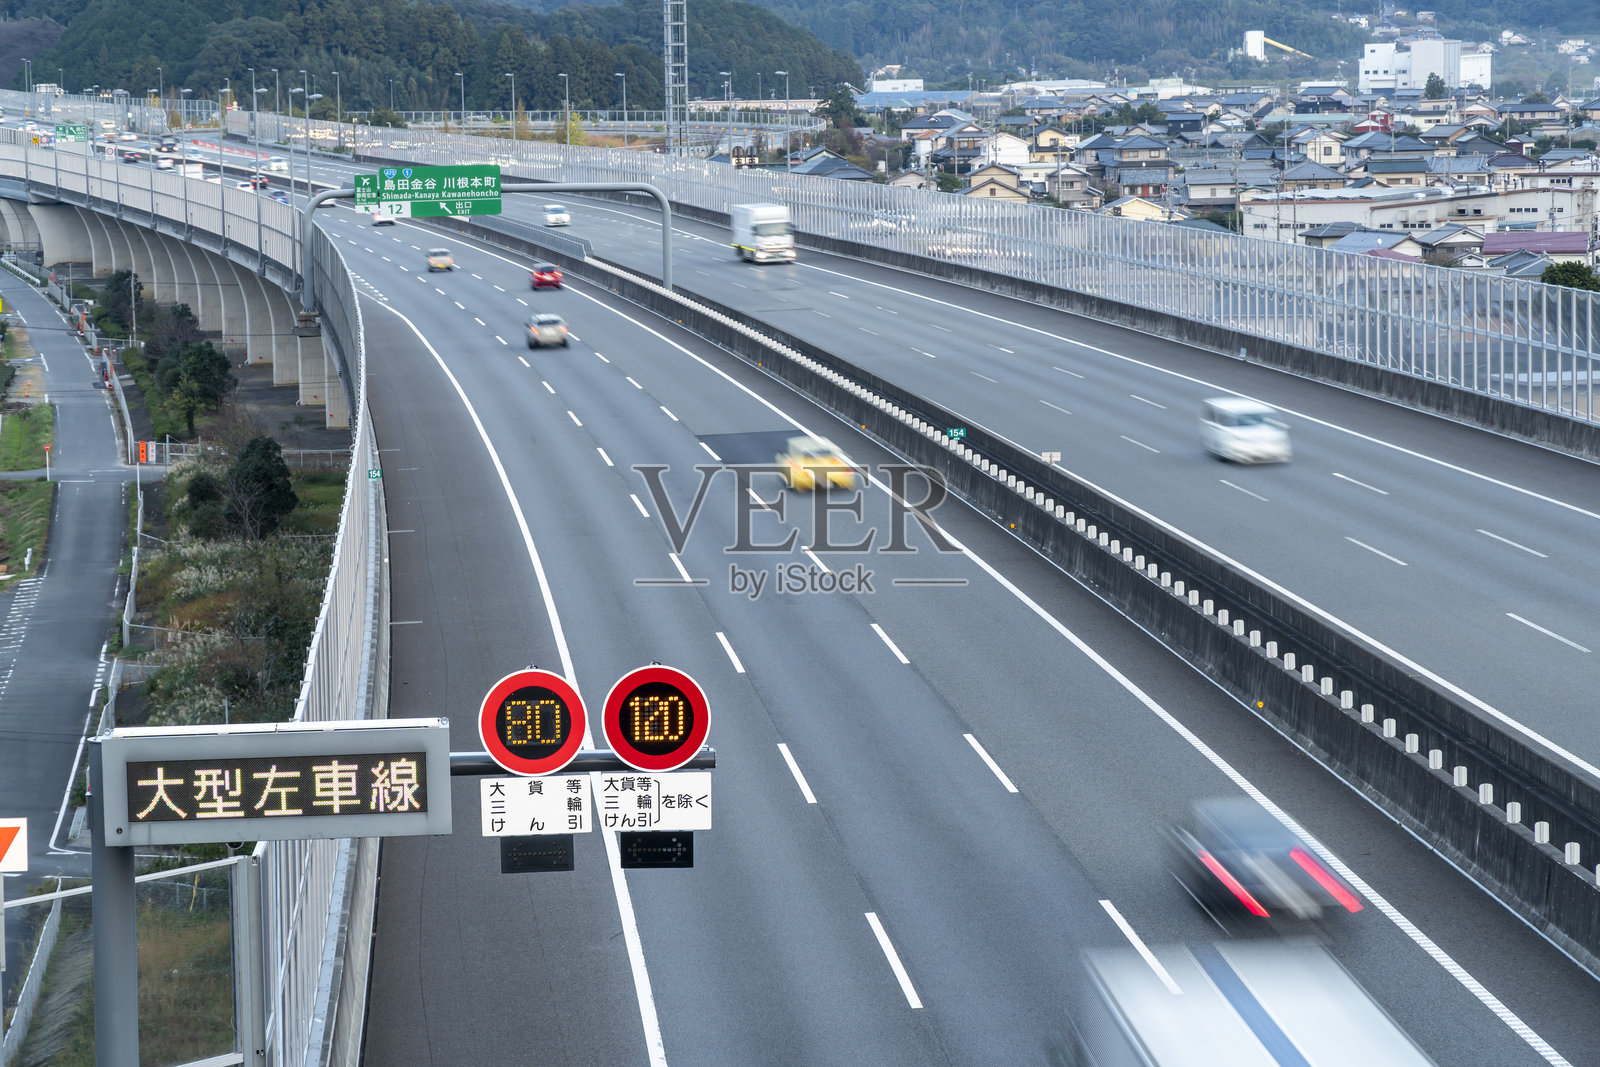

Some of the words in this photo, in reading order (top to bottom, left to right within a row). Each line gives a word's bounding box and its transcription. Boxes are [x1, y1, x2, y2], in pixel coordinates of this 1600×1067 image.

[384, 178, 437, 190] 島田金谷
[443, 176, 496, 189] 川根本町
[382, 192, 440, 200] Shimada-Kanaya
[442, 190, 499, 198] Kawanehoncho
[388, 204, 403, 214] 12
[456, 201, 472, 209] 出口
[949, 428, 964, 437] 154
[370, 470, 380, 478] 154
[506, 699, 561, 744] 80
[629, 695, 684, 741] 120
[136, 757, 421, 820] 大型左車線
[604, 776, 652, 792] 大貨等
[604, 794, 652, 810] 三輪
[662, 794, 708, 808] を除く
[604, 812, 652, 828] けん引
